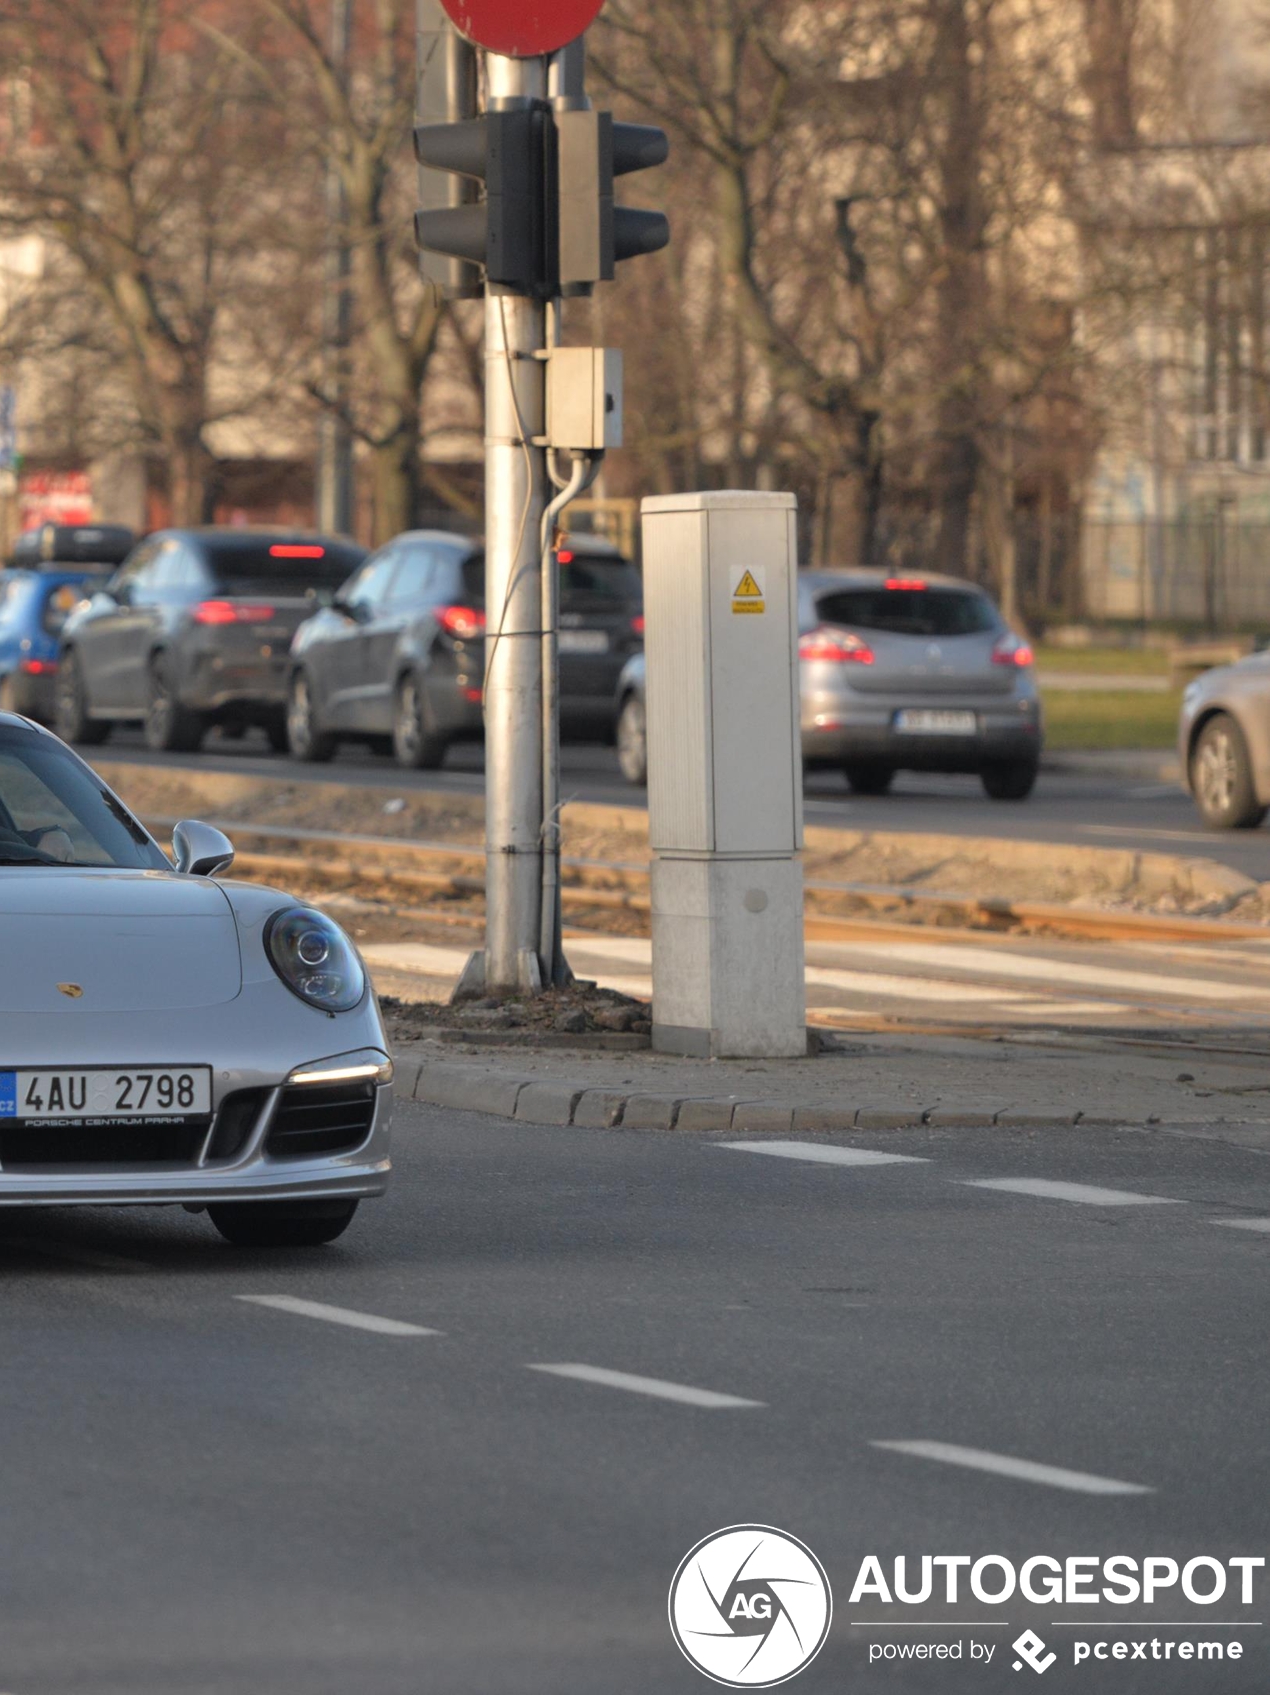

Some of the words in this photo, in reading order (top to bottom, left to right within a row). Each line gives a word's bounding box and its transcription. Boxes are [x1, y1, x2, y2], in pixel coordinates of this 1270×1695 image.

[25, 1076, 86, 1111] 4AU
[115, 1074, 195, 1110] 2798
[25, 1119, 82, 1127] PORSCHE
[85, 1118, 143, 1126] CENTRUM
